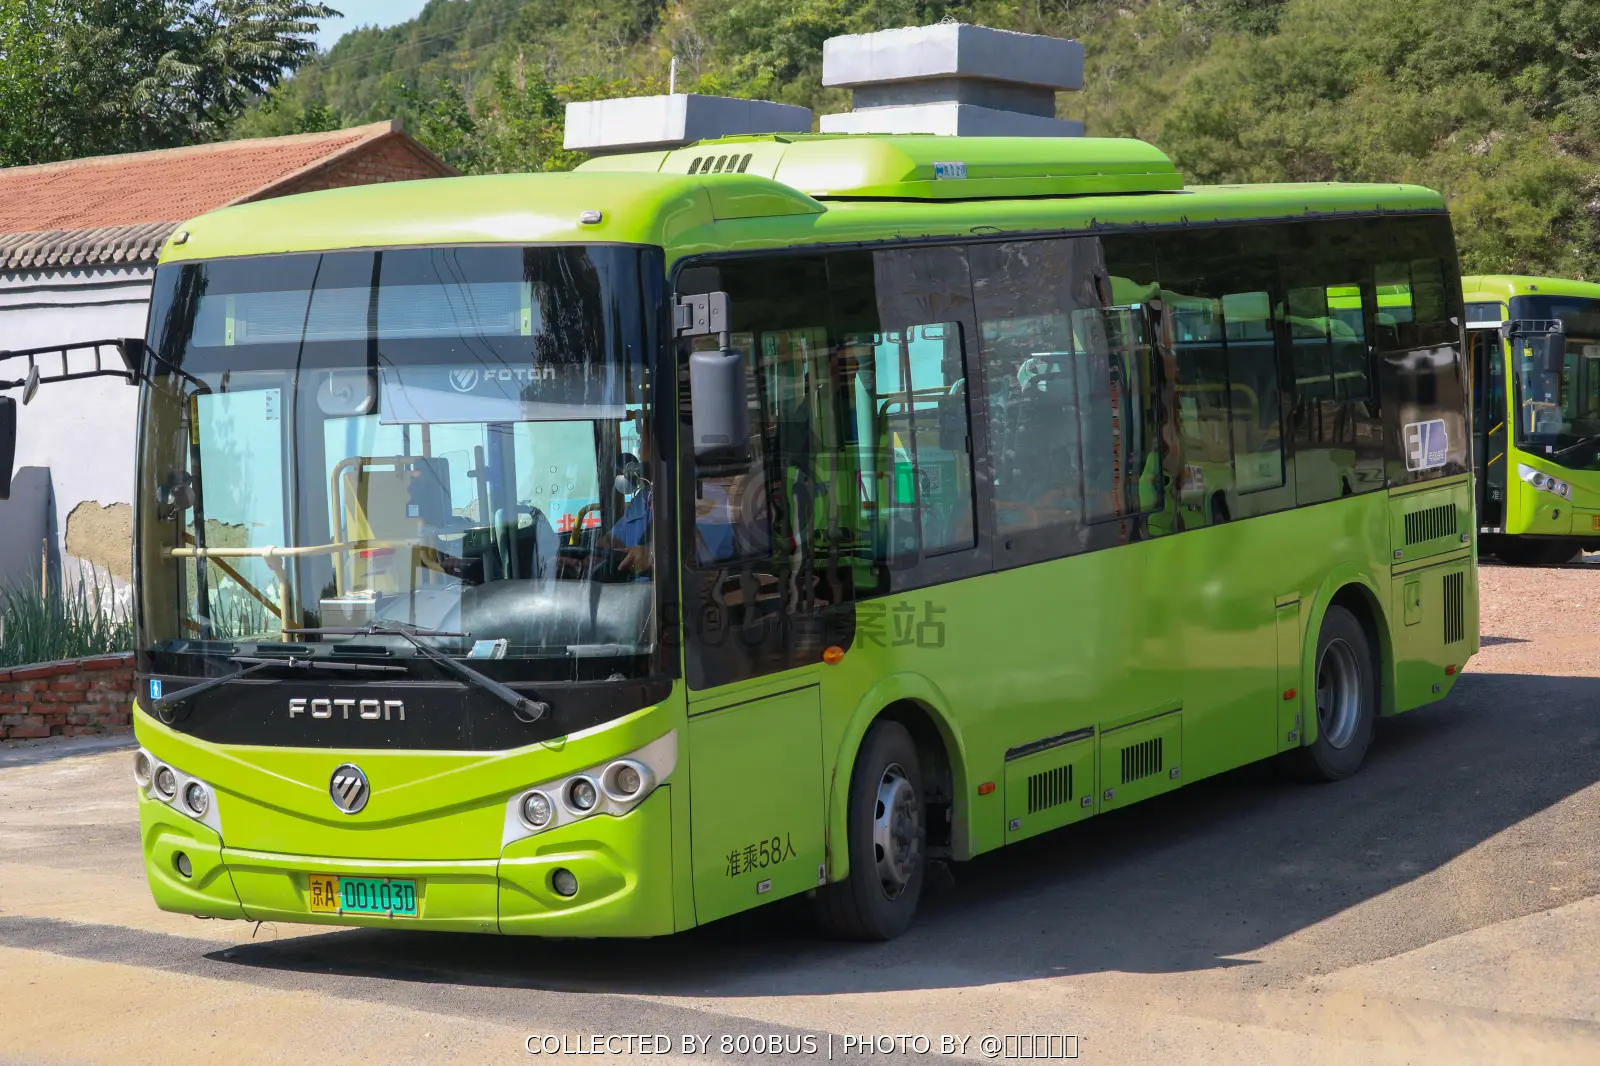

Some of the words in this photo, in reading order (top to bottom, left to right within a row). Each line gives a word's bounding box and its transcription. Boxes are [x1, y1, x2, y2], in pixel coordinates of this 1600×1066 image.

[484, 368, 556, 381] FOTON
[288, 698, 406, 721] FOTON
[725, 832, 797, 879] 准乘58人
